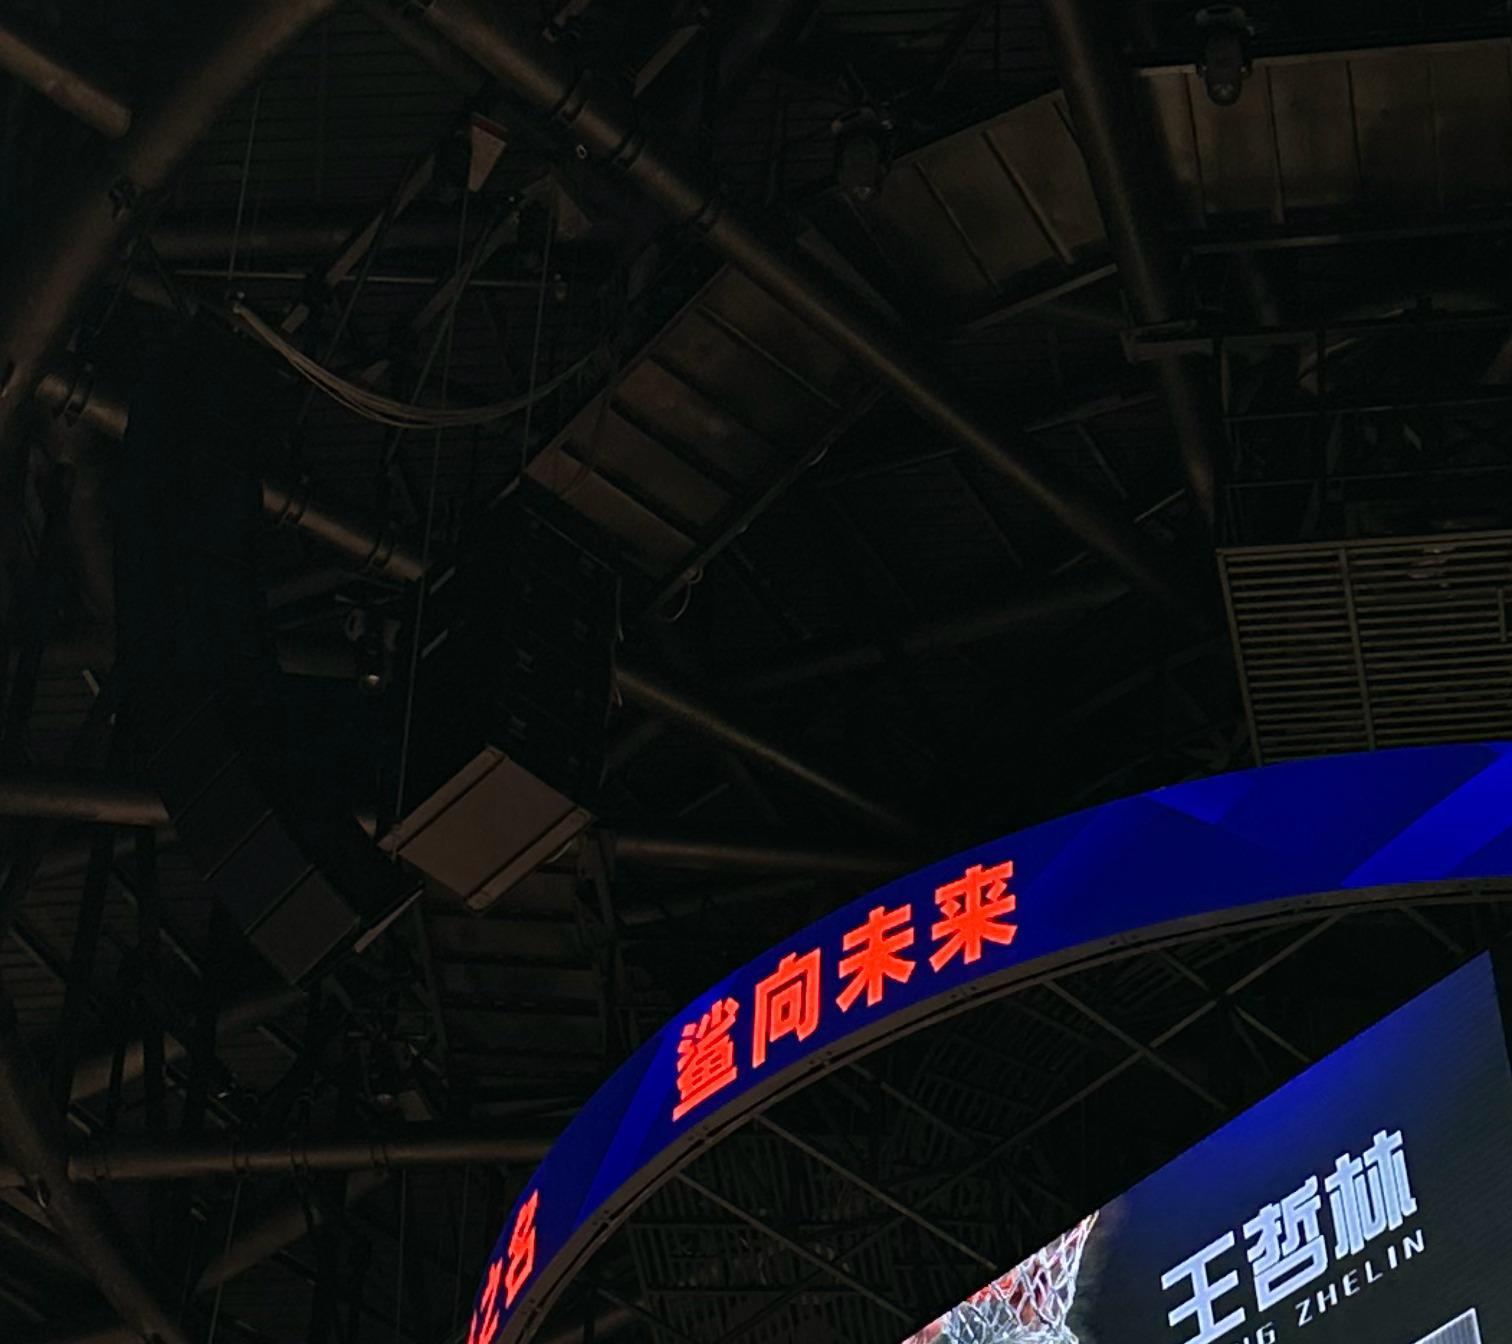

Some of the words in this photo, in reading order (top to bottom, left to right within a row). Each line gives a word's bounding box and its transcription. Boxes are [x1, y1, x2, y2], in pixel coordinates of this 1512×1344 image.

[672, 860, 1018, 1122] 鲨向未来
[1295, 1229, 1425, 1327] ZHELIN
